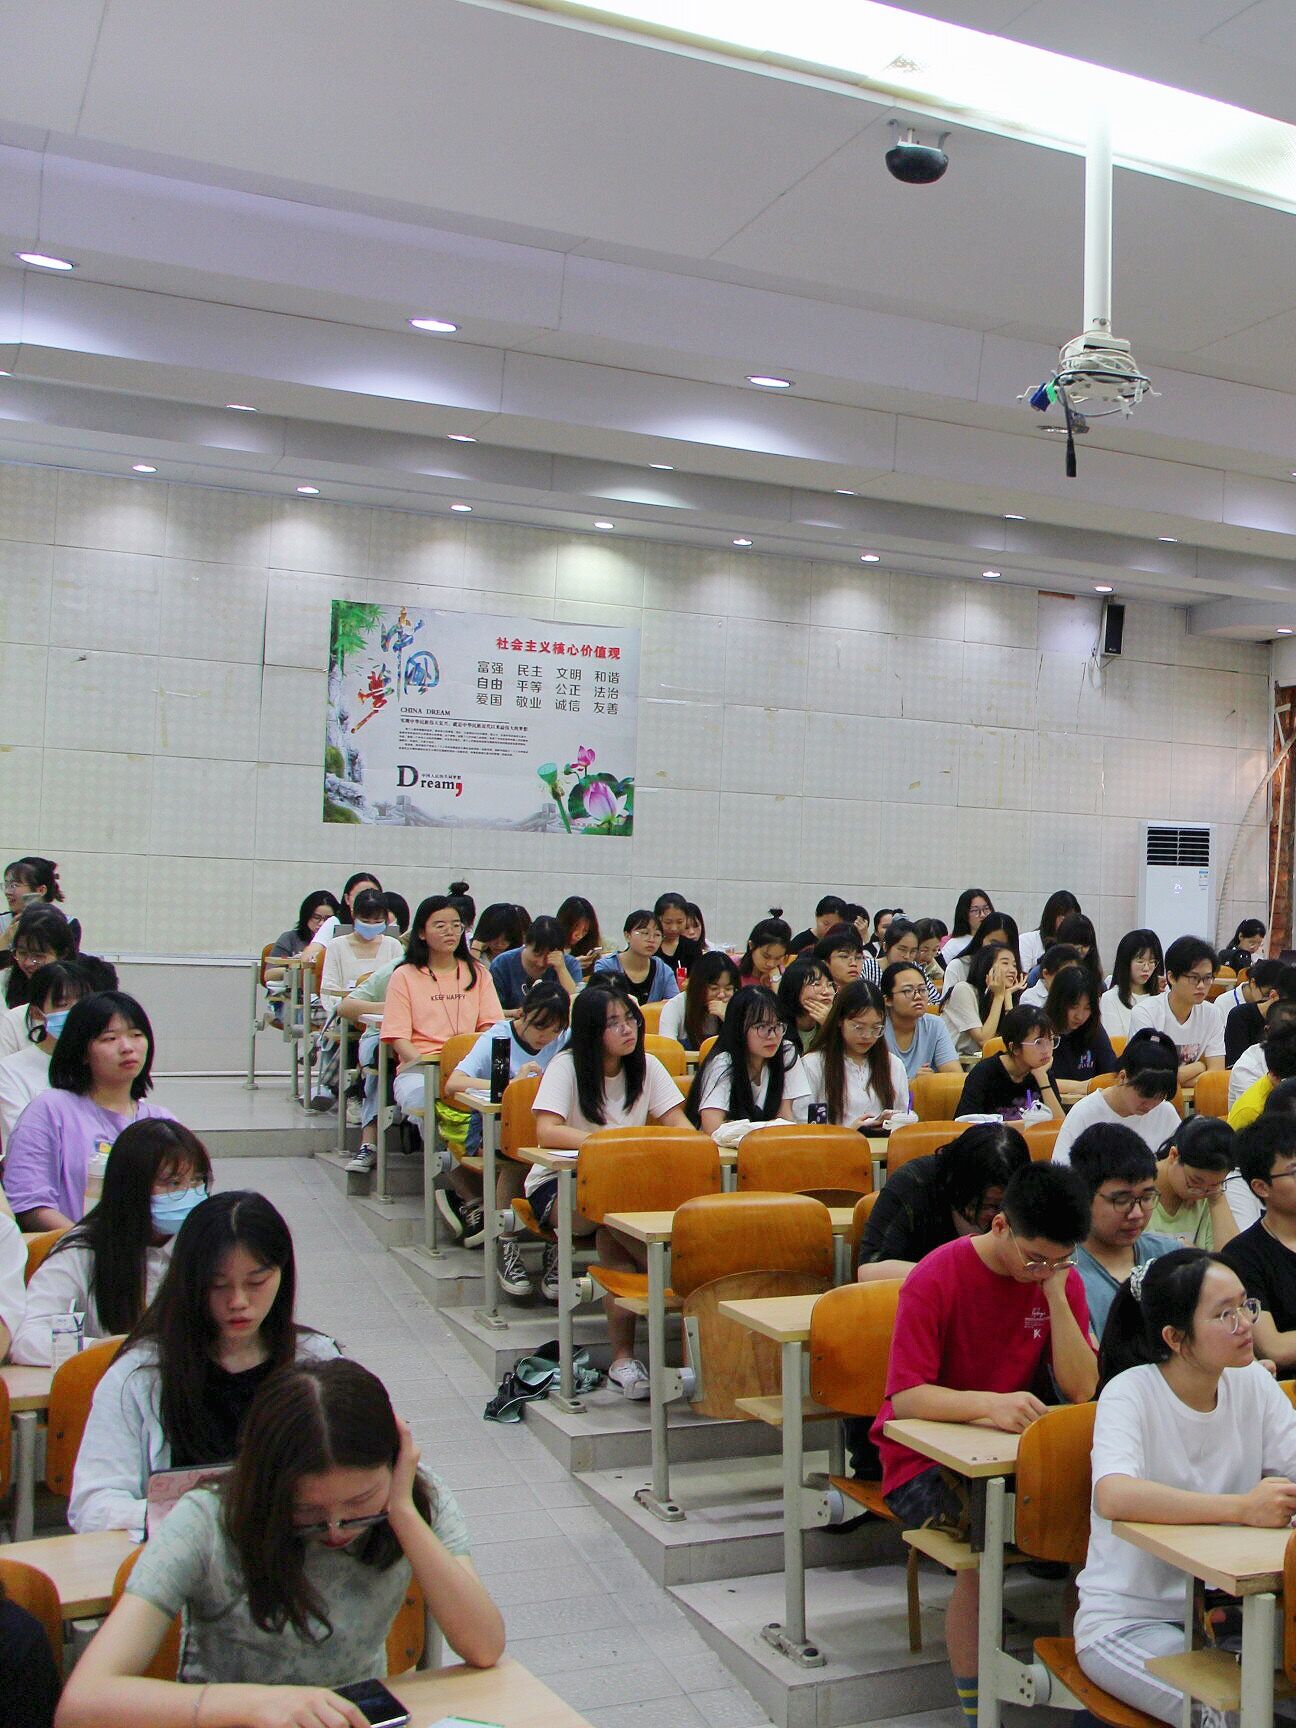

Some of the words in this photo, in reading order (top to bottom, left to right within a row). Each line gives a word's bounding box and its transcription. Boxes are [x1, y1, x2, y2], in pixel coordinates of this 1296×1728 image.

[496, 636, 622, 661] 社会主义核心价值观
[477, 660, 504, 676] 富强
[517, 664, 544, 679] 民主
[555, 667, 582, 681] 文明
[594, 669, 620, 684] 和谐
[476, 676, 503, 691] 自由
[516, 679, 543, 694] 平等
[555, 683, 581, 697] 公正
[593, 685, 620, 700] 法治
[400, 706, 422, 714] CHINA
[426, 708, 451, 717] DREAM
[475, 692, 503, 707] 爱国
[516, 695, 542, 710] 敬业
[554, 698, 581, 713] 诚信
[593, 700, 619, 716] 友善
[446, 993, 466, 1001] HAPPY
